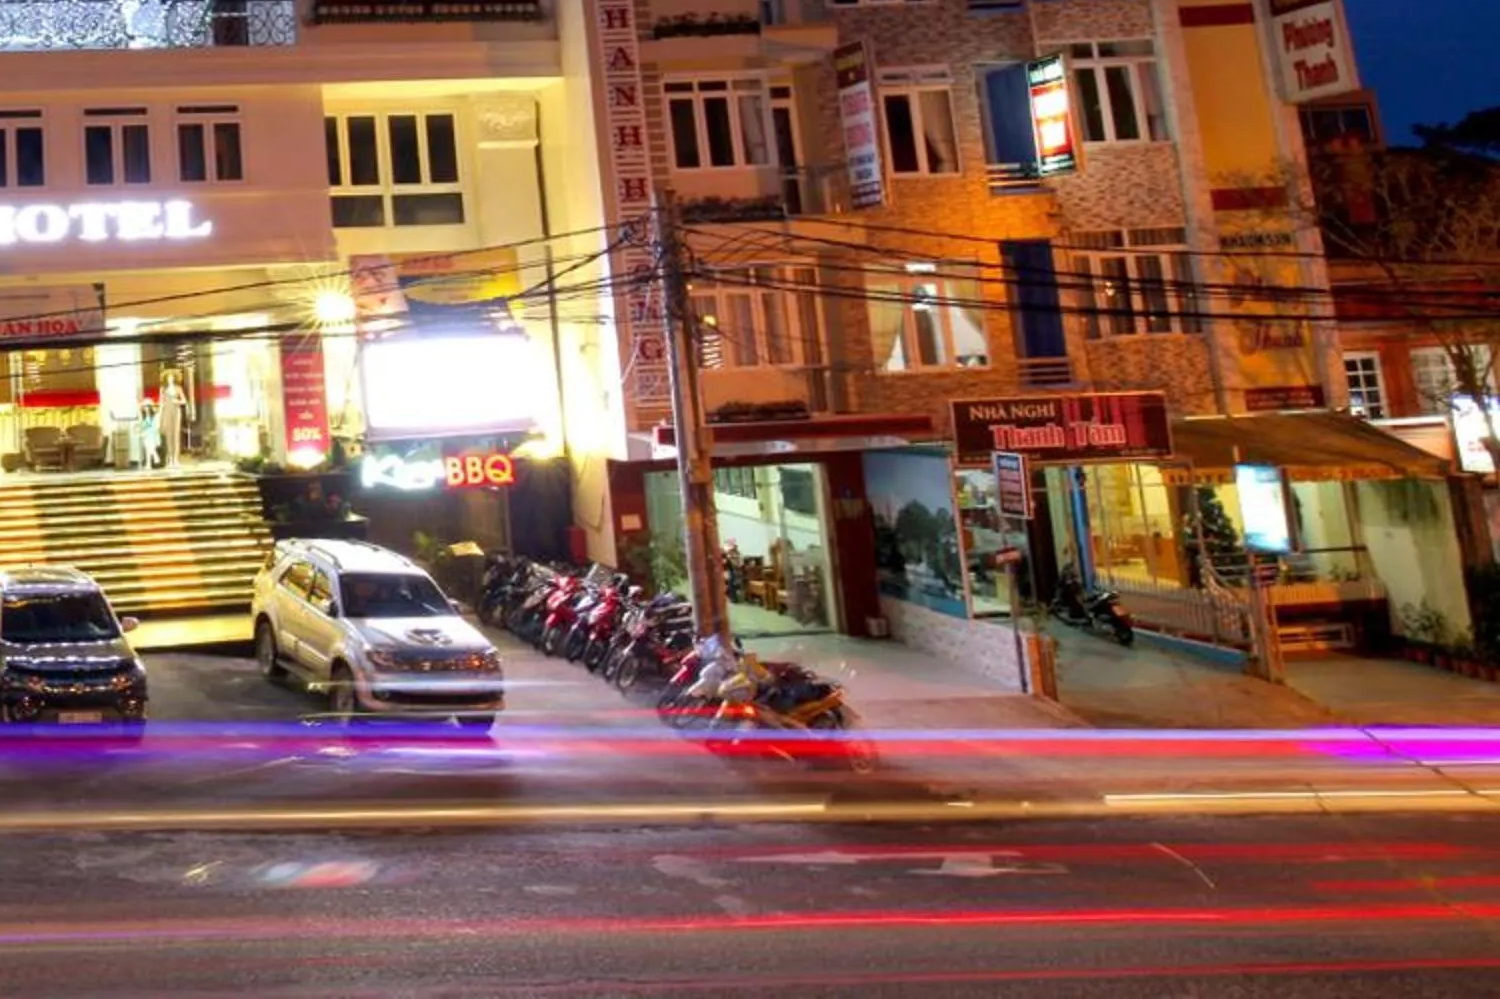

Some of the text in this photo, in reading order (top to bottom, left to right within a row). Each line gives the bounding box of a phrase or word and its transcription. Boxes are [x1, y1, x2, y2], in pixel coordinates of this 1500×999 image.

[968, 405, 1008, 421] NHÀ
[988, 422, 1066, 450] Thanh
[445, 453, 515, 487] BBQ
